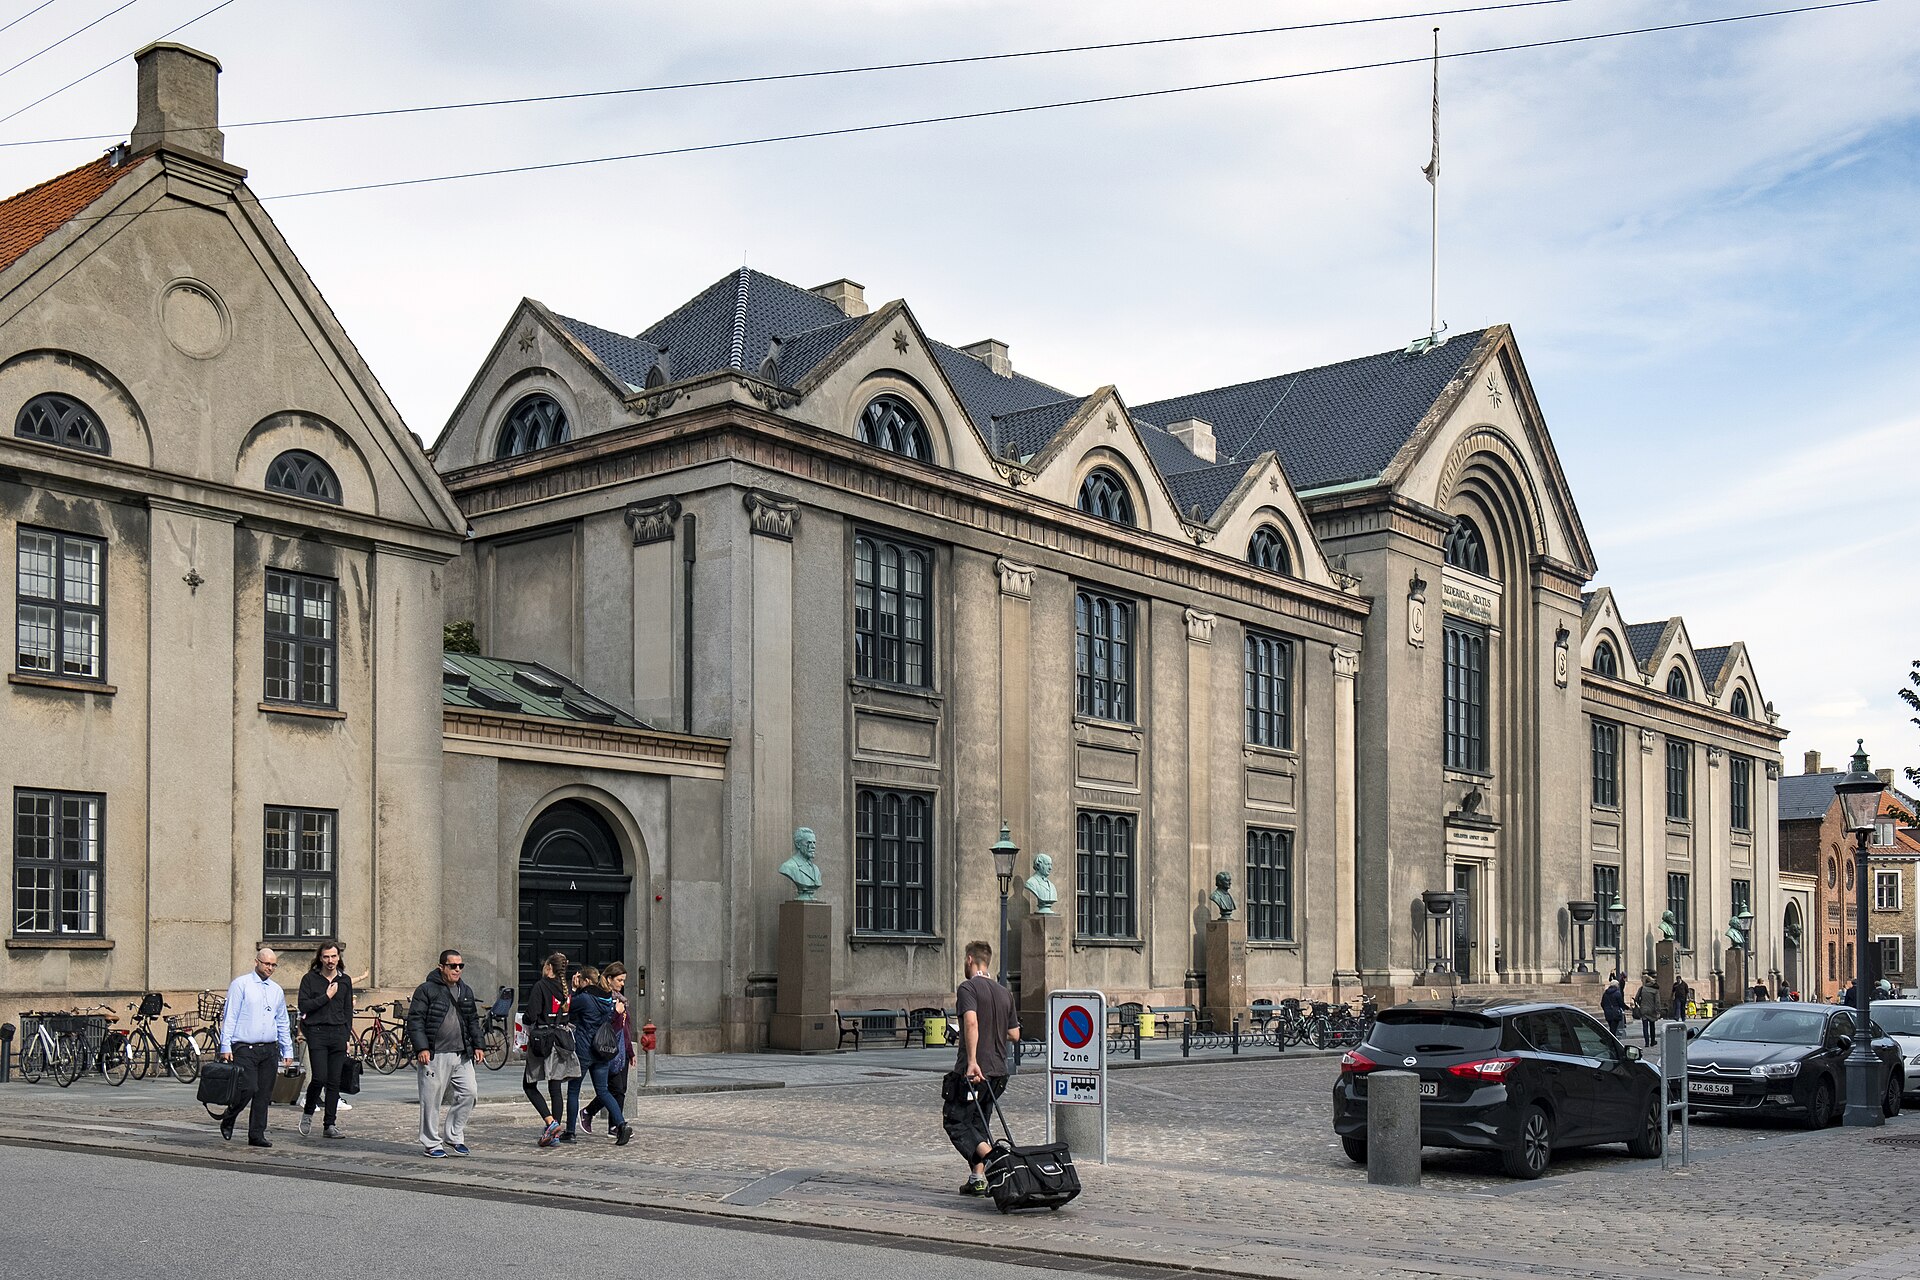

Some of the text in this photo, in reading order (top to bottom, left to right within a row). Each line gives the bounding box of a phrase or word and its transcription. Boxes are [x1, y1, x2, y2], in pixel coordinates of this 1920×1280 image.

[1473, 594, 1492, 608] SEXTUS
[570, 881, 577, 890] A
[1063, 1051, 1089, 1062] Zone
[1058, 1082, 1066, 1094] P
[1692, 1083, 1730, 1094] ZP 48 548
